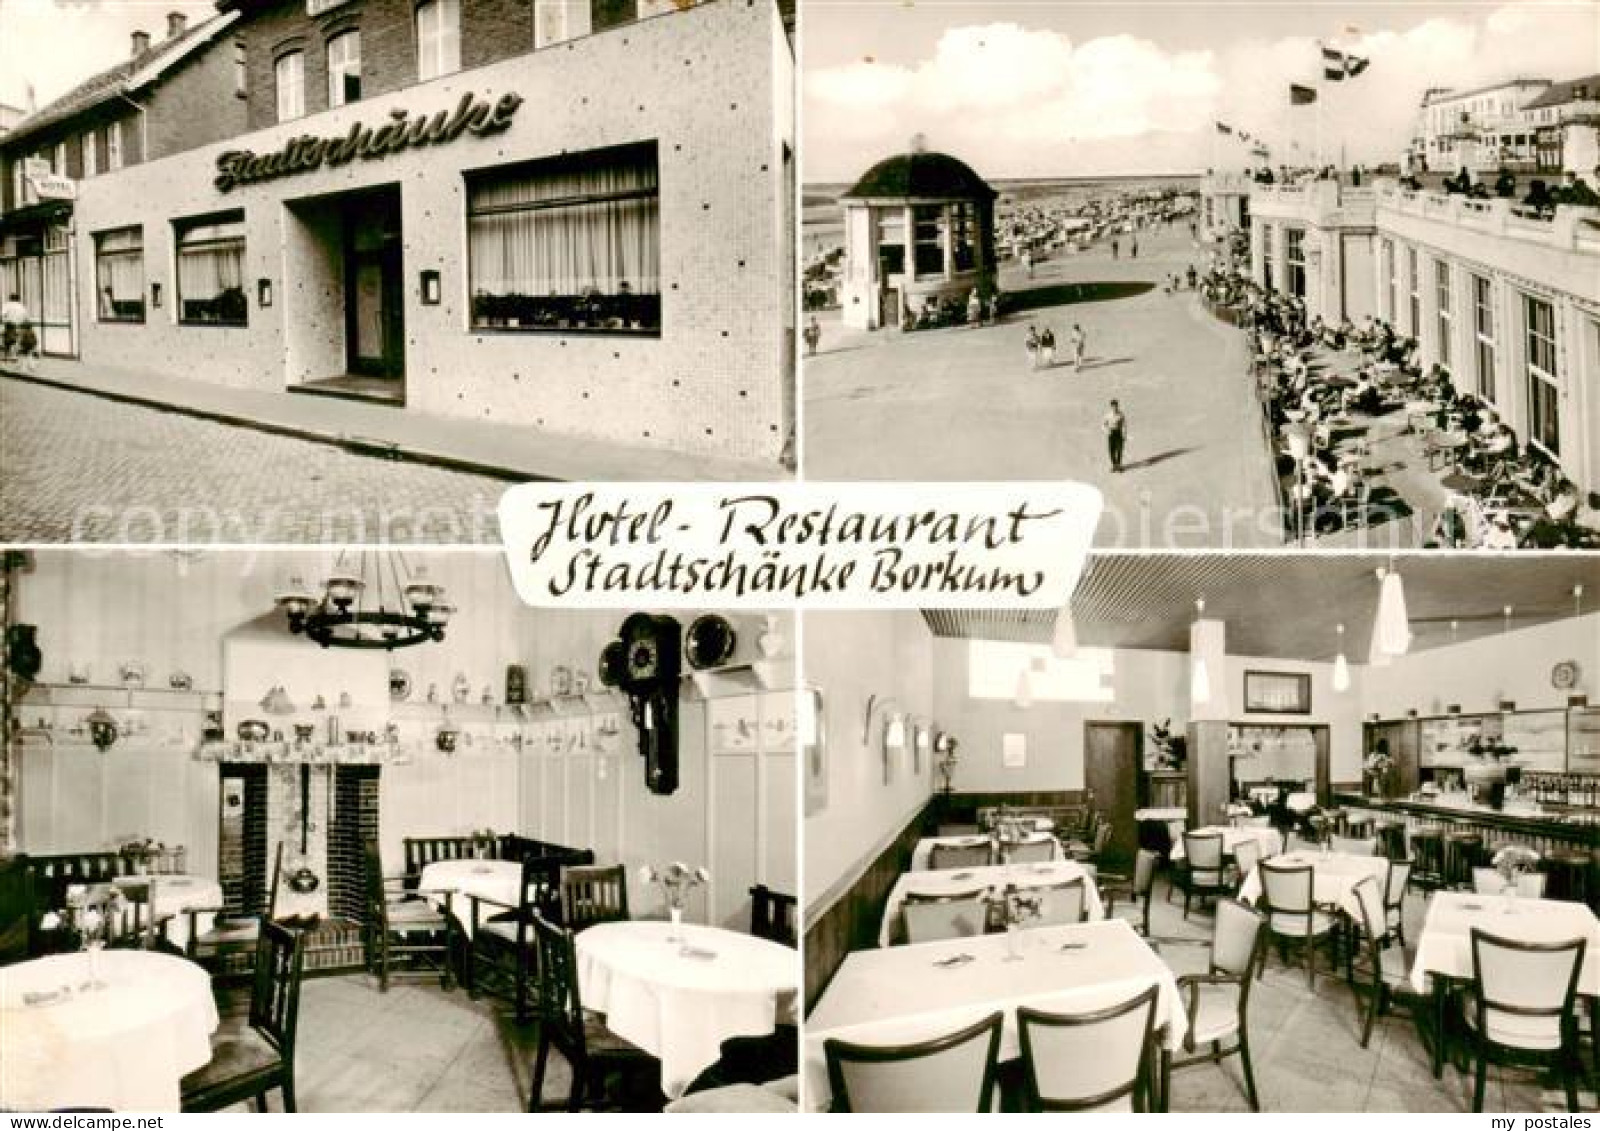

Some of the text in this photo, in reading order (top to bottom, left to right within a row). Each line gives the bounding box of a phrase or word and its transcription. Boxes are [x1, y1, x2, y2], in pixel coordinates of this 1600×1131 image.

[213, 91, 524, 193] Stadtschänke
[719, 495, 1066, 550] Restaurant
[548, 547, 1045, 598] Stadtschänke Borkum
